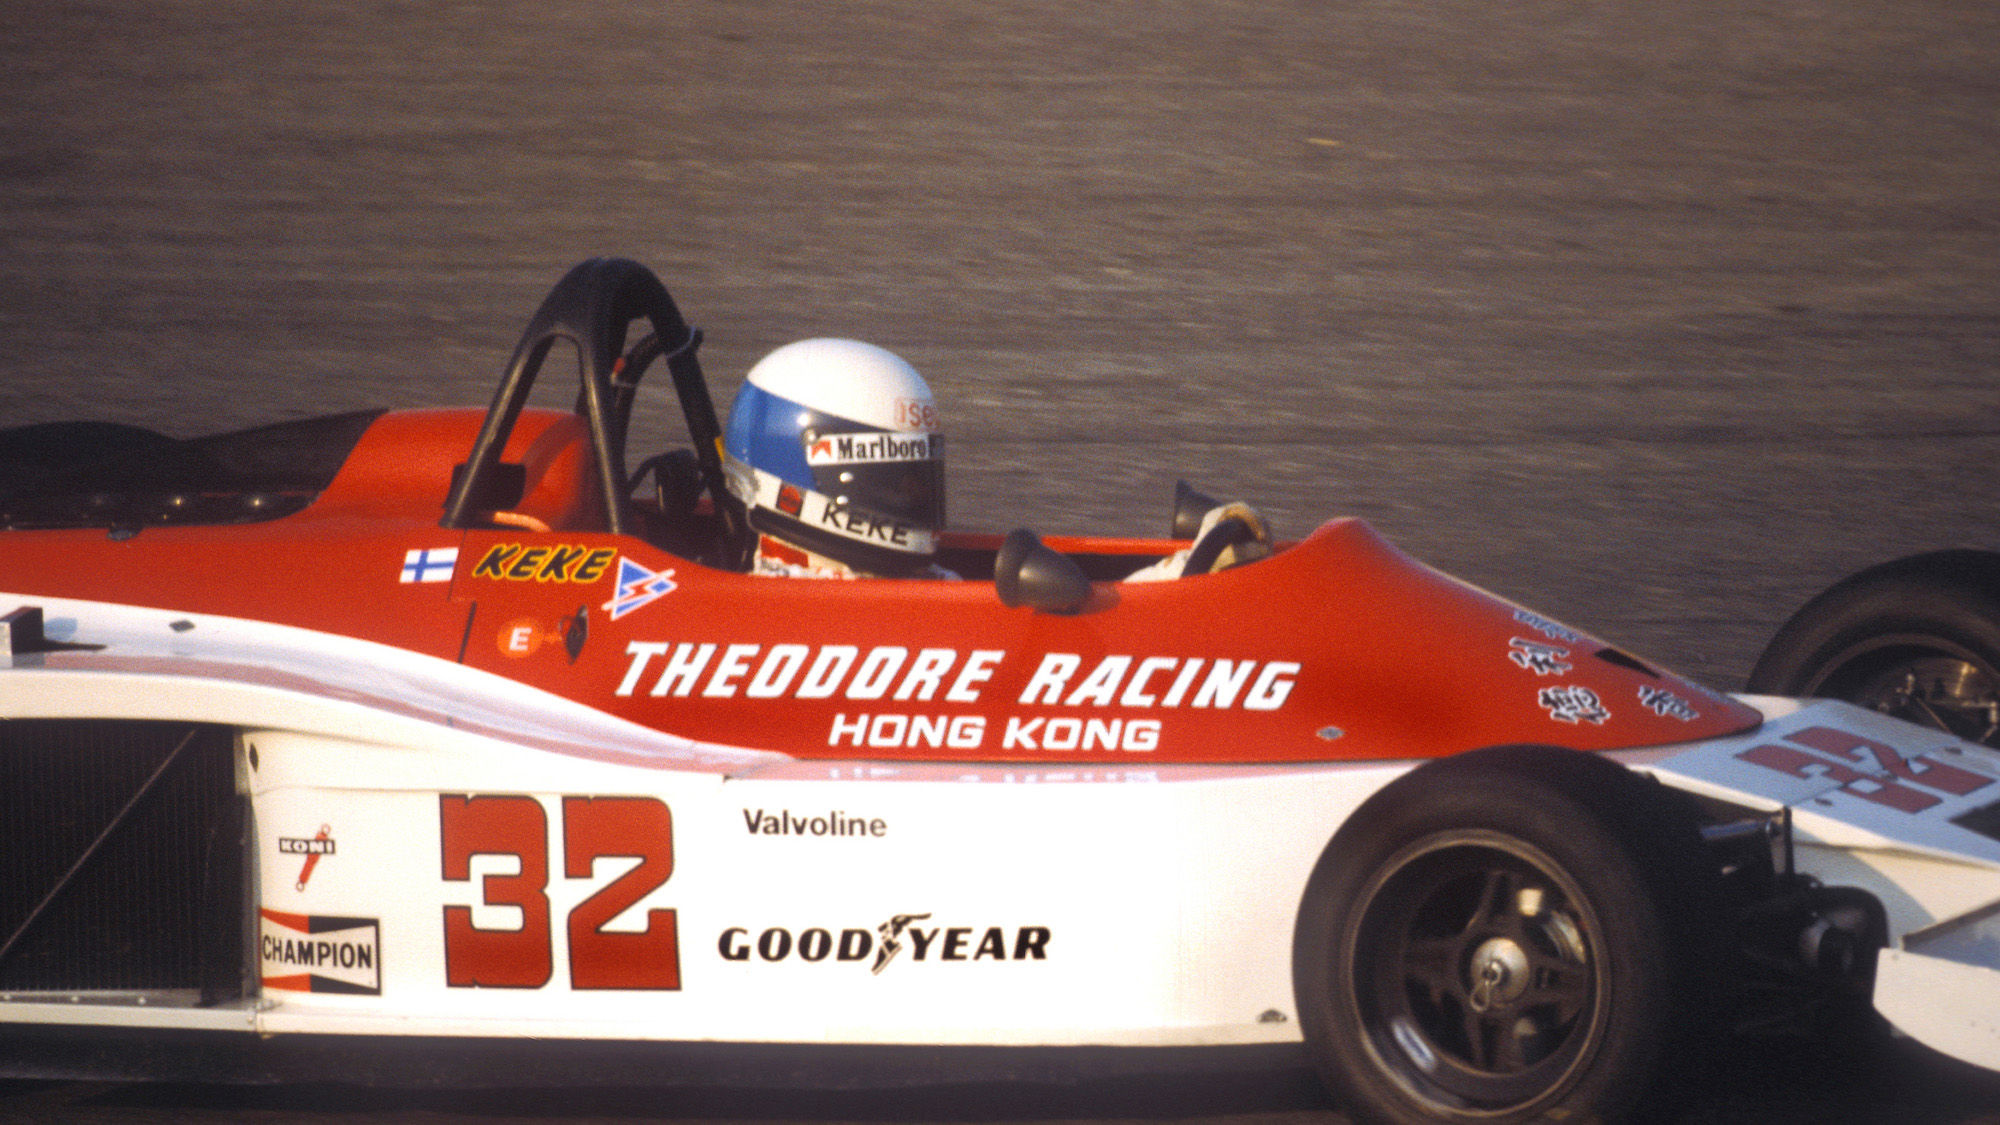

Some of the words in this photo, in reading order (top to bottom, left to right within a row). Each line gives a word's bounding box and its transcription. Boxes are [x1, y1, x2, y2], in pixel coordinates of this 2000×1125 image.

[837, 434, 927, 460] Marlboro
[822, 500, 909, 546] KEKE
[472, 543, 618, 583] KEKE
[509, 626, 533, 651] E
[614, 640, 1006, 702] THEODORE
[1017, 653, 1303, 710] RACING
[827, 713, 987, 750] HONG
[1001, 717, 1163, 752] KONG
[1733, 726, 1997, 815] 32
[743, 808, 888, 837] Valvoline
[279, 838, 335, 854] KONI
[438, 792, 682, 991] 32
[262, 934, 373, 970] CHAMPION
